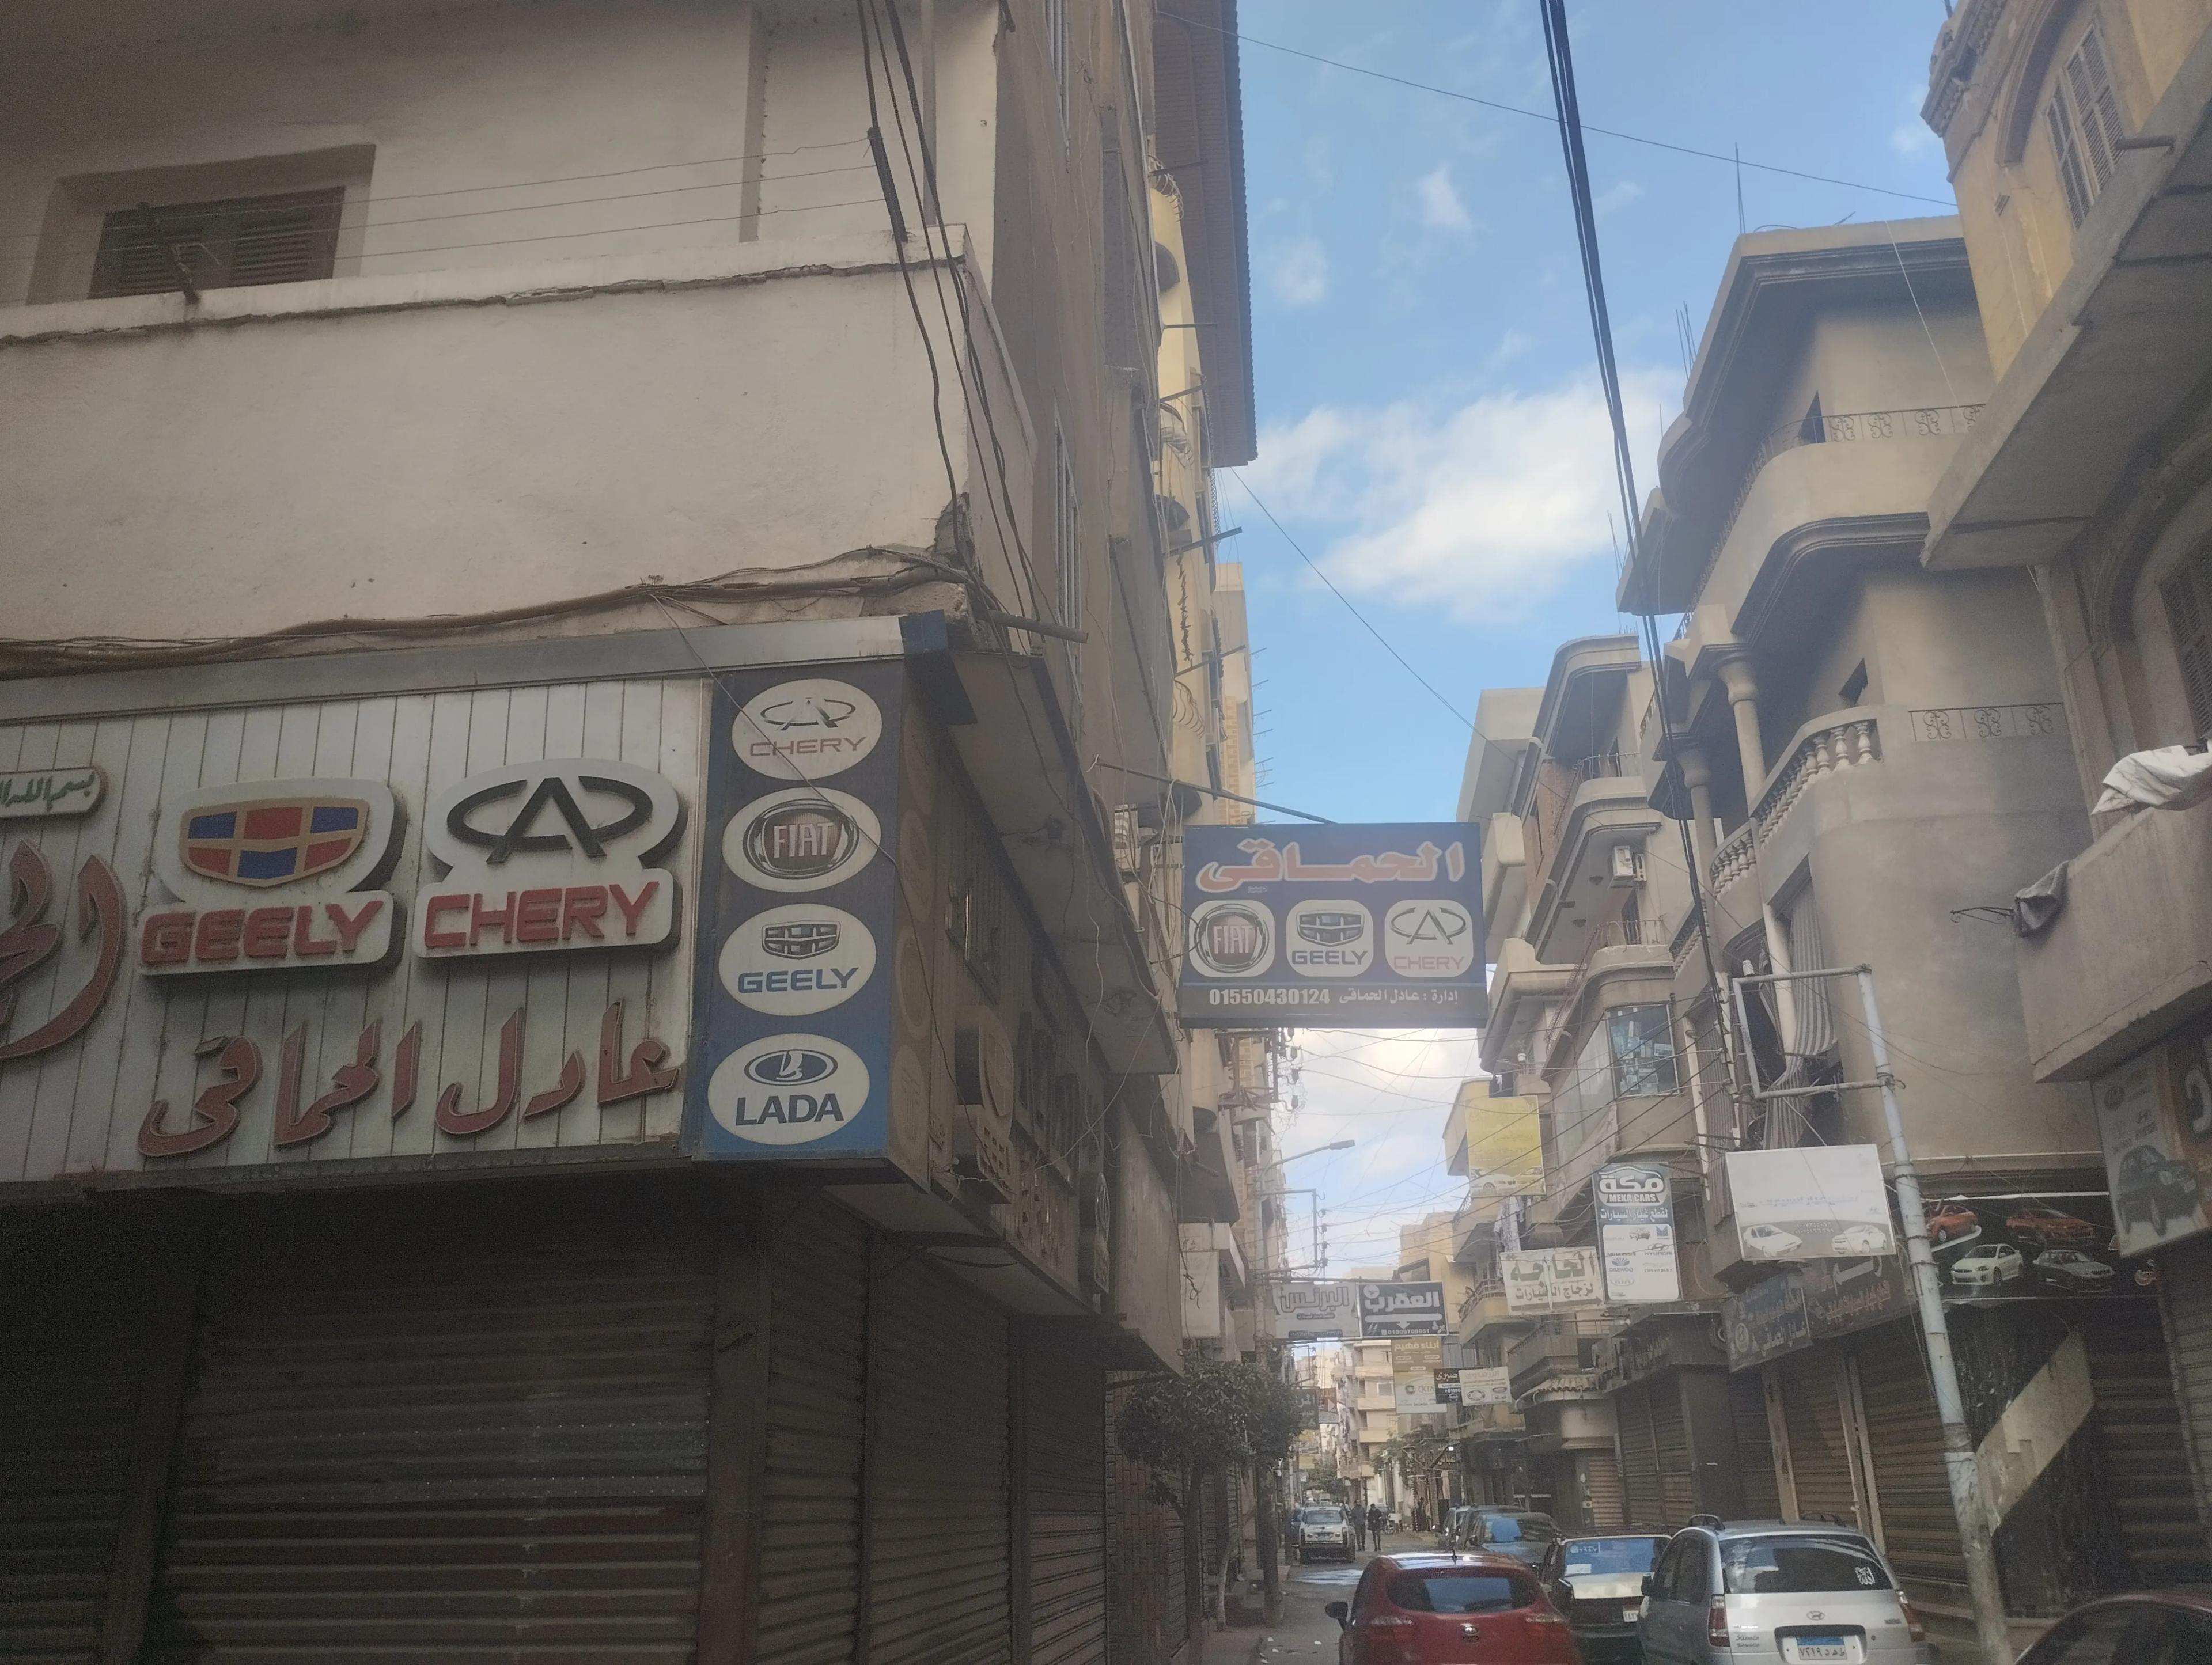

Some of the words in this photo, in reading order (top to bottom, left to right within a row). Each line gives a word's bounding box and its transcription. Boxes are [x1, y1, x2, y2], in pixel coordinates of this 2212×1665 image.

[750, 737, 866, 757] CHERY
[773, 822, 835, 859] FIAT
[424, 881, 660, 949] CHERY
[139, 900, 384, 964] GEELY
[1213, 924, 1253, 955] FIAT
[1291, 950, 1369, 965] GEELY
[1393, 955, 1465, 970] CHERY
[738, 968, 859, 993] GEELY
[1210, 988, 1331, 1006] 01550430124
[1390, 989, 1419, 1004] عادل
[1430, 989, 1458, 1005] إدارة
[435, 998, 680, 1136] عادل
[735, 1093, 844, 1126] LADA
[1599, 1175, 1664, 1193] مكة
[1609, 1194, 1632, 1203] MEKA
[1634, 1193, 1656, 1202] CARS
[1600, 1208, 1631, 1221] السيارات
[1364, 1291, 1440, 1313] العقرب
